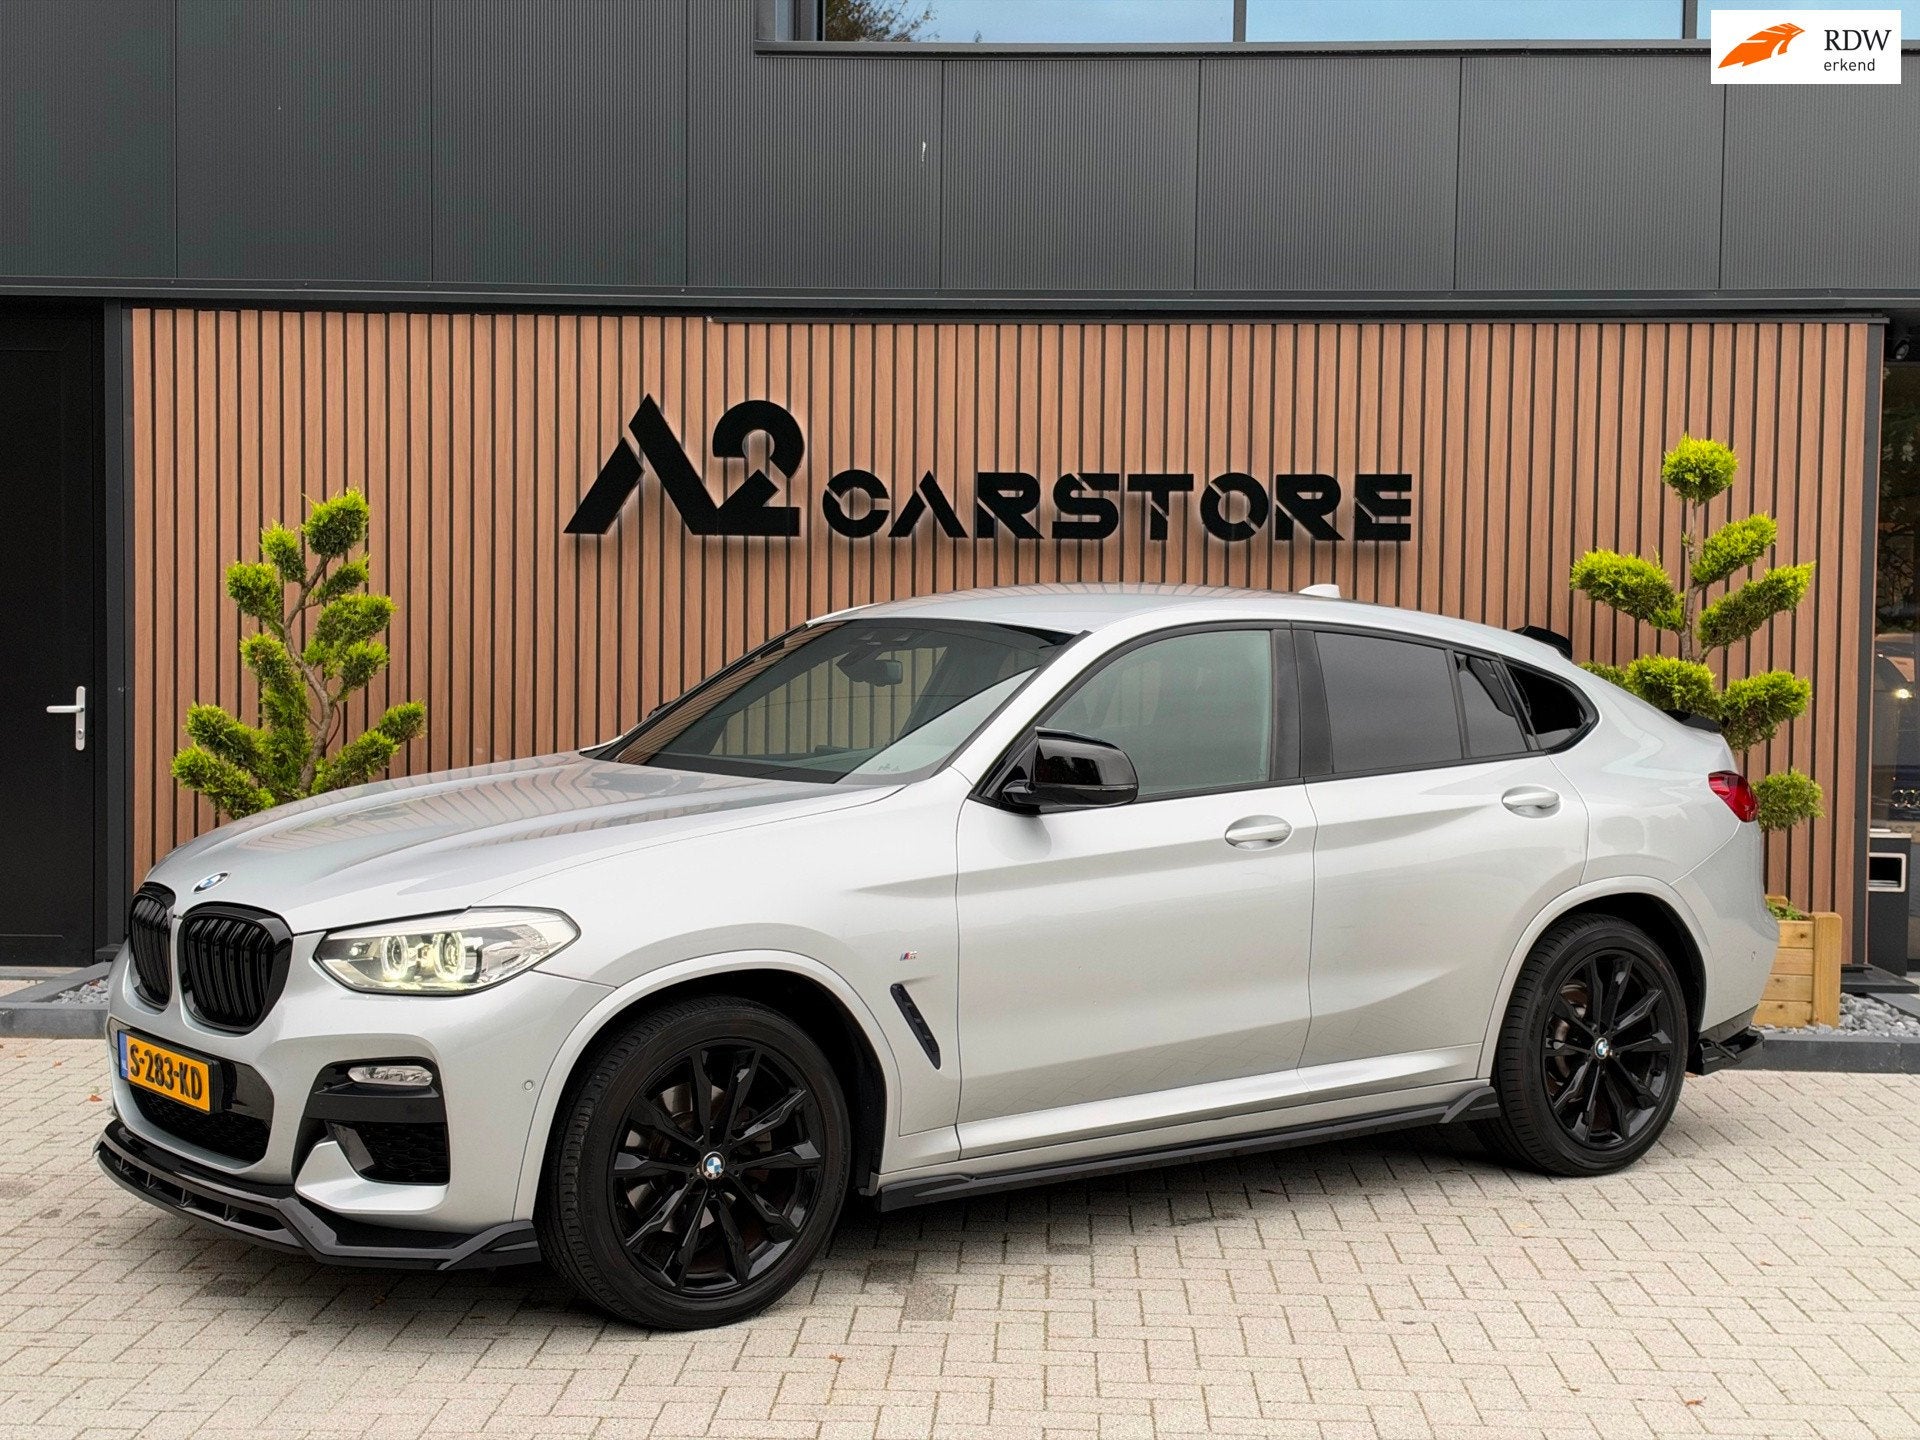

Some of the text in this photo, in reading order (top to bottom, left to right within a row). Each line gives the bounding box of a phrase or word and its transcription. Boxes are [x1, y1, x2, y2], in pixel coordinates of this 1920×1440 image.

[563, 393, 1413, 542] A2 CARSTORE
[130, 1043, 203, 1101] S-283-KD
